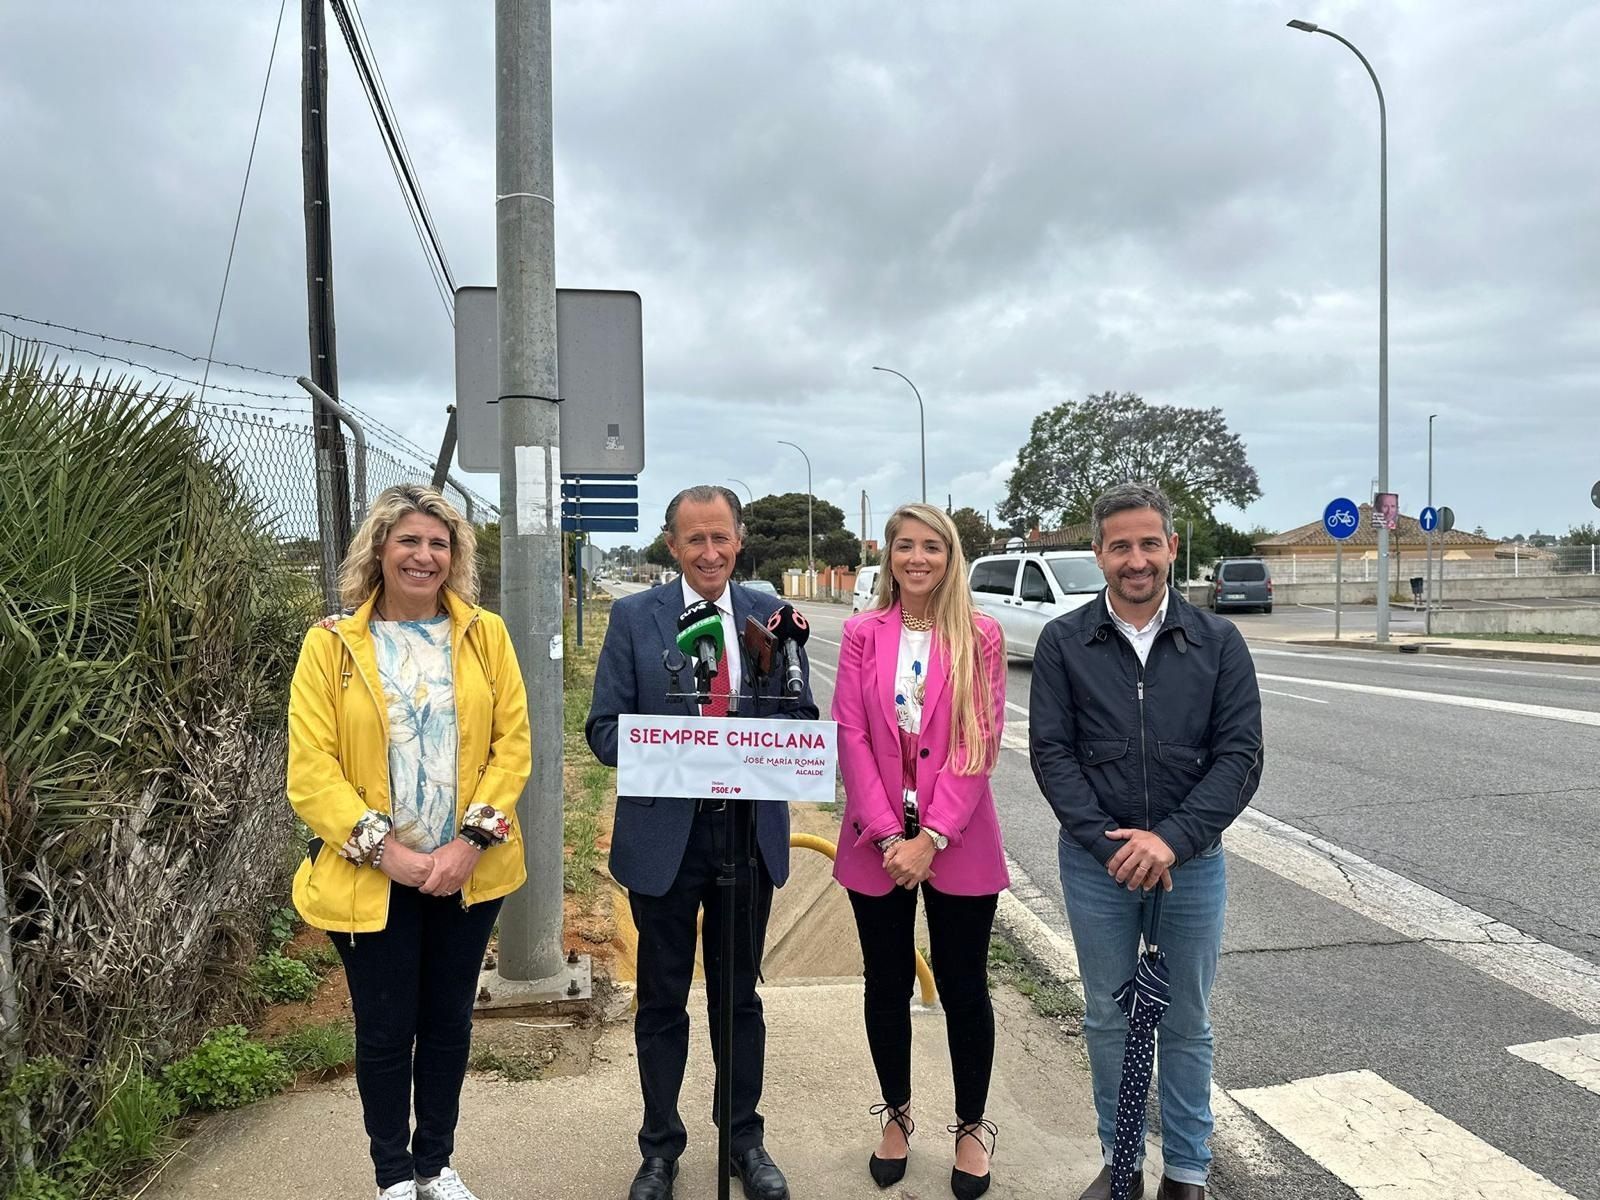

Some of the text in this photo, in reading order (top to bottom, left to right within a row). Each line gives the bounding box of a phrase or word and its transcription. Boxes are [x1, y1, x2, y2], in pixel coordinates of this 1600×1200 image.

[629, 728, 826, 749] SIEMPRE CHICLANA
[743, 755, 825, 768] JOSÉ MARÍA ROMÁN
